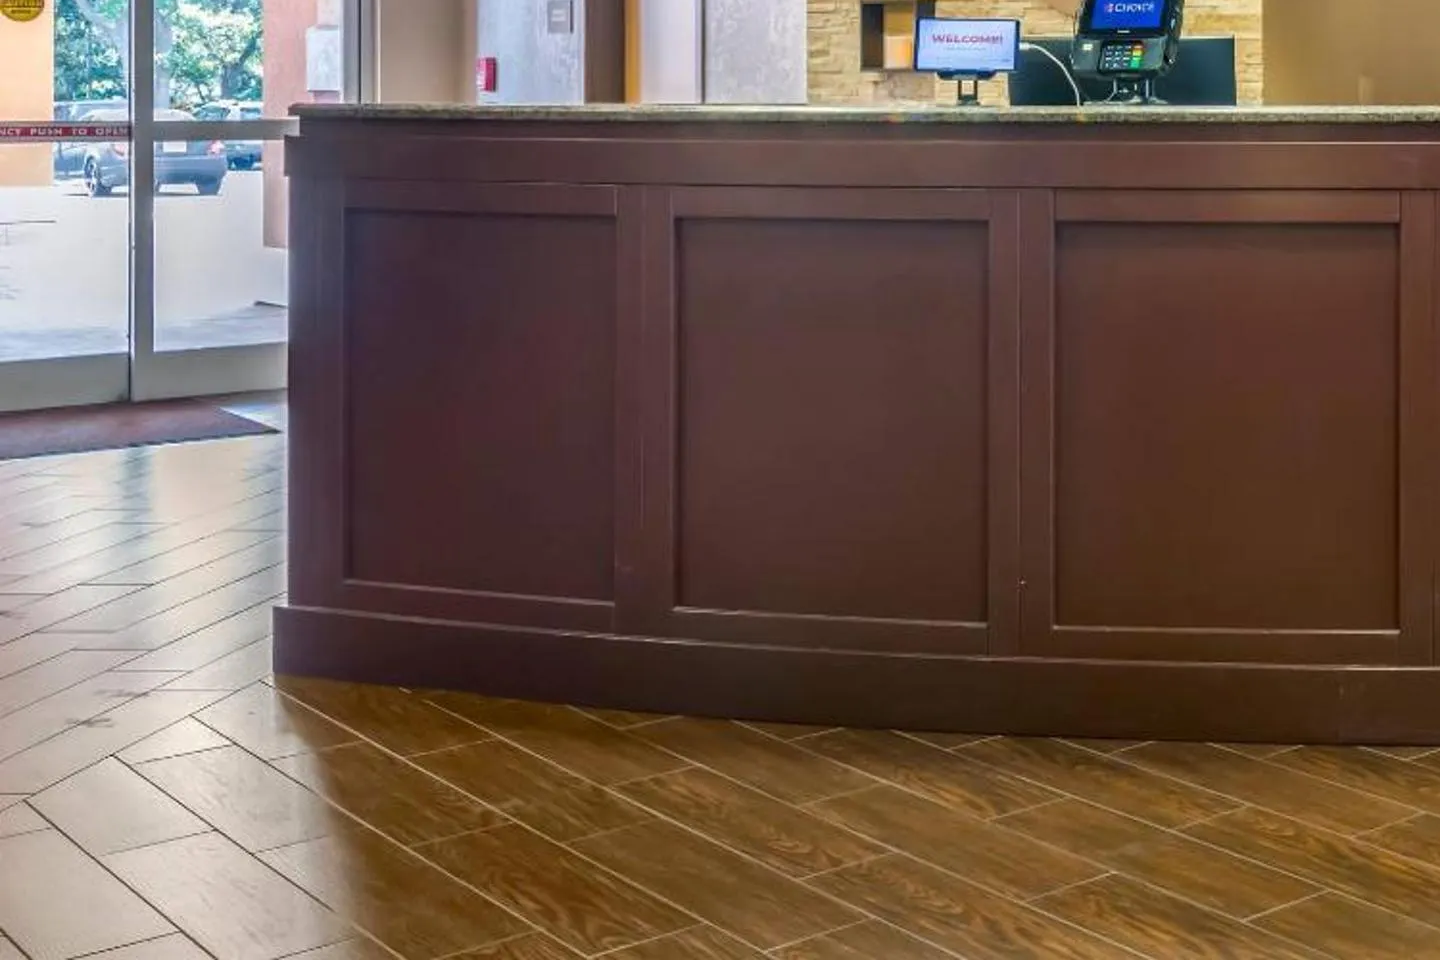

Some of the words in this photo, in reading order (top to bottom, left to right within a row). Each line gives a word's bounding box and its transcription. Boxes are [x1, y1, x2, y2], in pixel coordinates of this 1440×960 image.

[30, 127, 63, 136] PUSH
[71, 127, 88, 136] TO
[95, 127, 128, 136] OPEN
